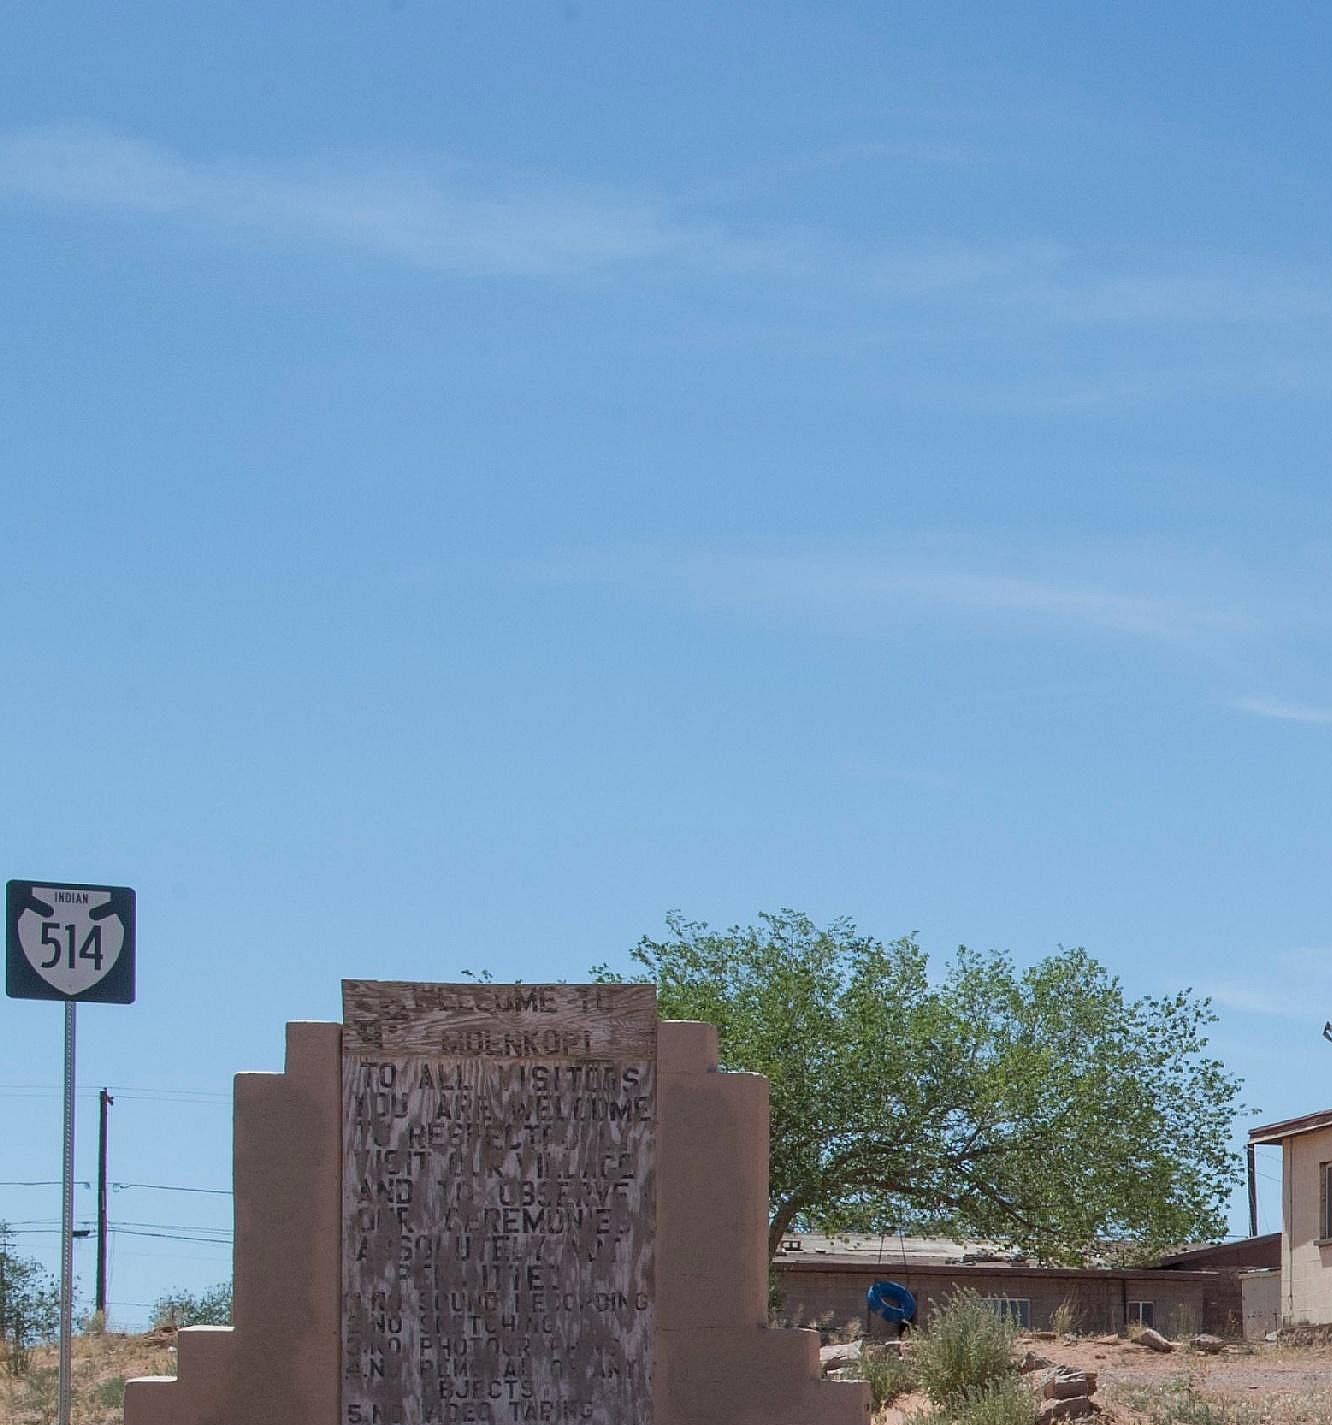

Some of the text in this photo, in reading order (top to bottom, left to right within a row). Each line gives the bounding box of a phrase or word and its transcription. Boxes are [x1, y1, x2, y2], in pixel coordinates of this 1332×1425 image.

[54, 891, 89, 905] INDIAN
[41, 921, 104, 971] 514
[361, 1061, 397, 1090] TO
[418, 1063, 474, 1091] ALL
[356, 1235, 546, 1263] ASOLUTELY
[398, 1263, 561, 1292] PEITTED
[419, 1359, 528, 1380] REMAL
[425, 1380, 534, 1400] BJECTS
